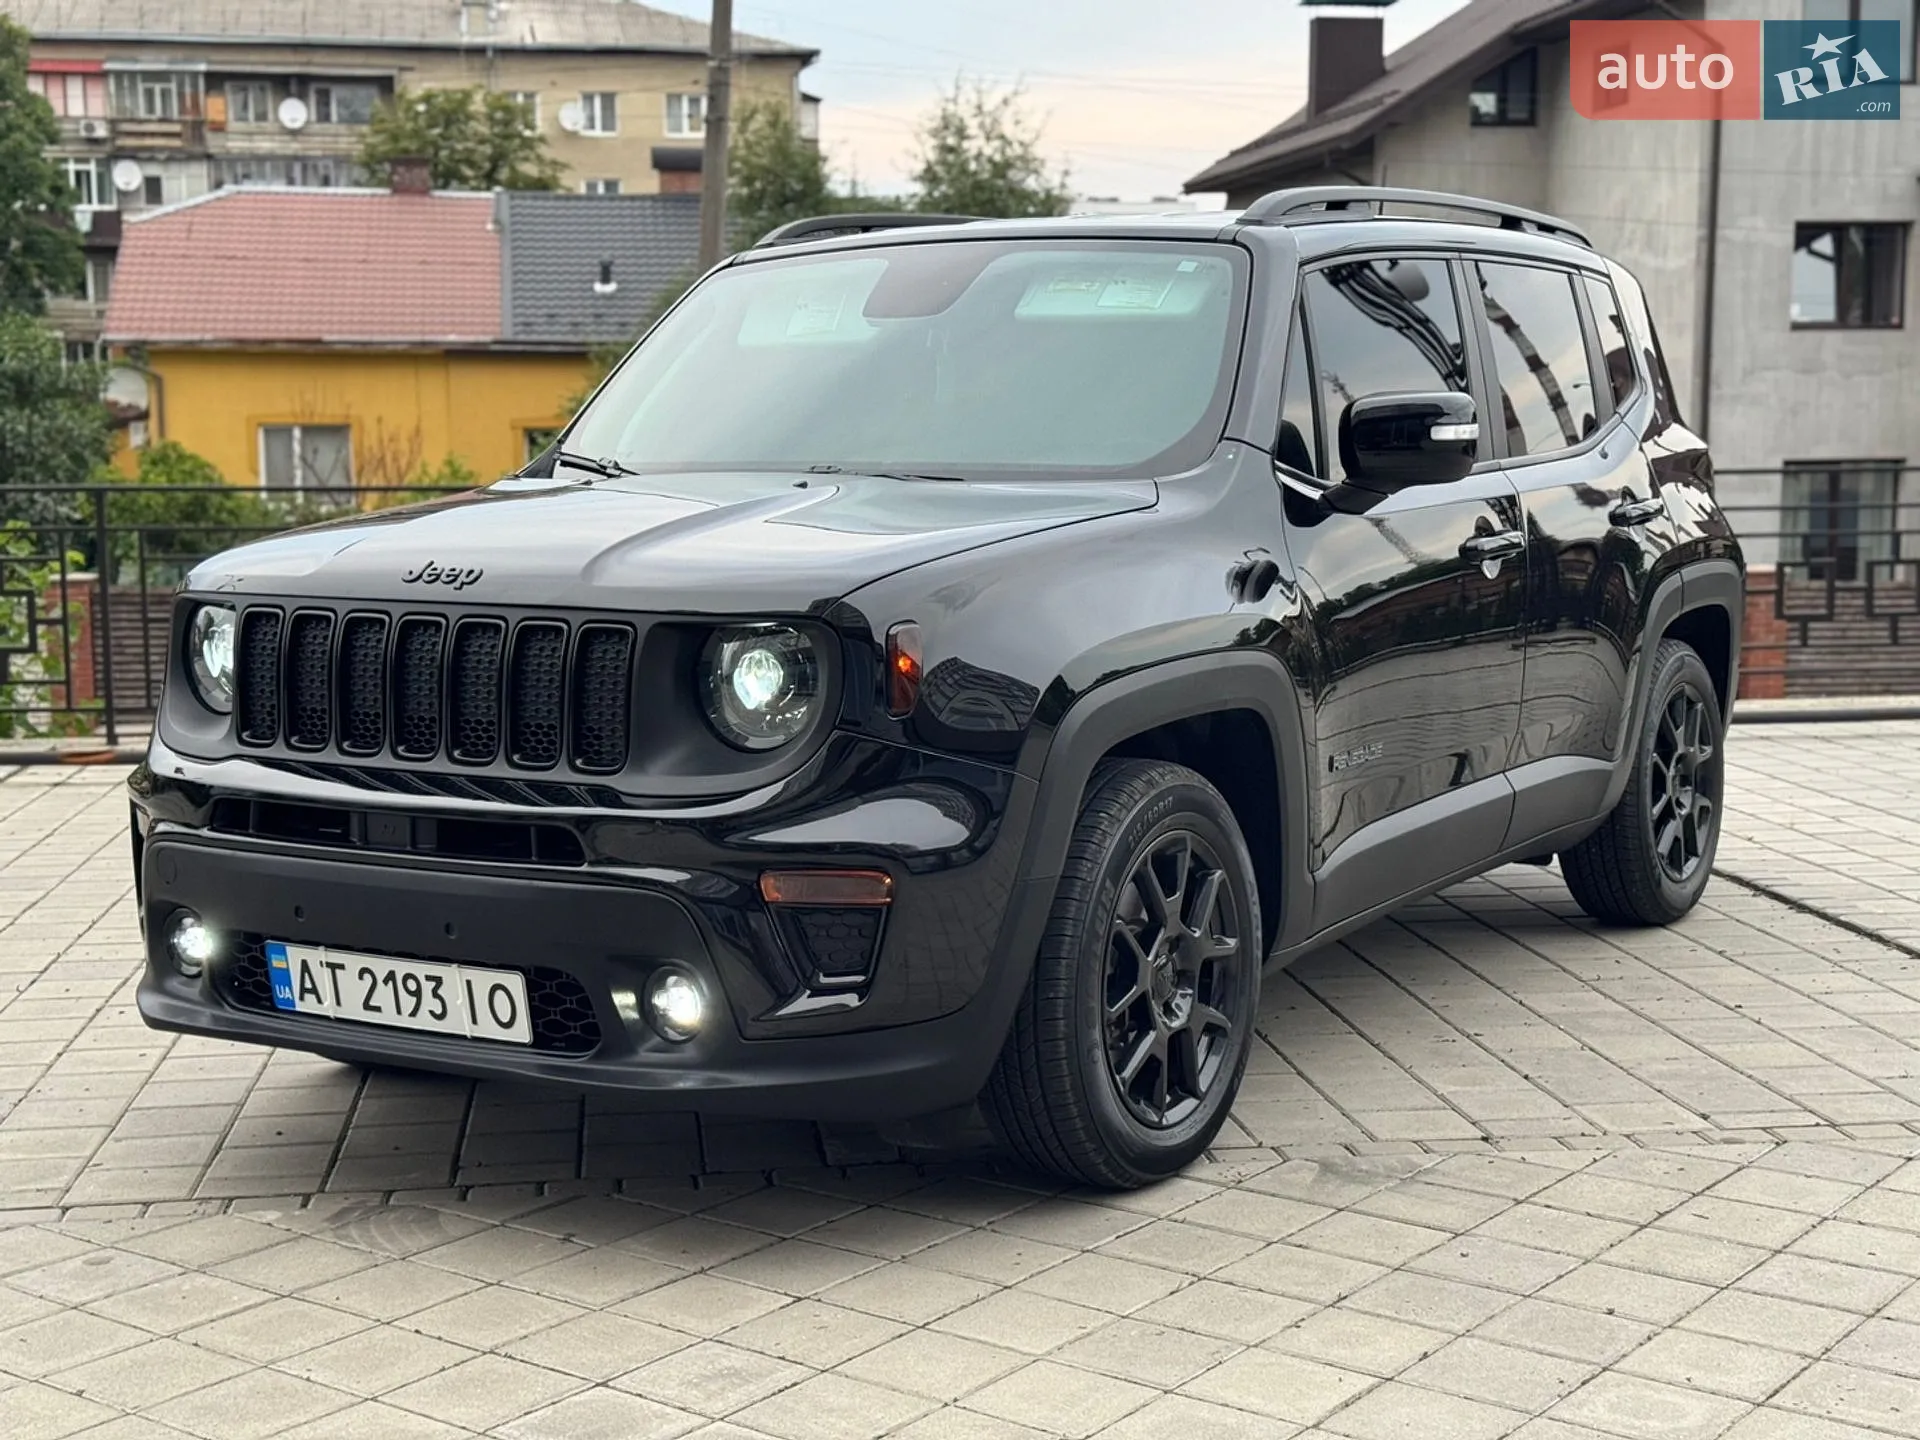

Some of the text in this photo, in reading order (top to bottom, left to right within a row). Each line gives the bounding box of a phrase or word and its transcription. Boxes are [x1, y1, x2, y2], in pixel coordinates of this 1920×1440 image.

[401, 560, 484, 591] Jeep
[274, 983, 294, 1000] UA
[298, 957, 518, 1030] AT 2193 IO
